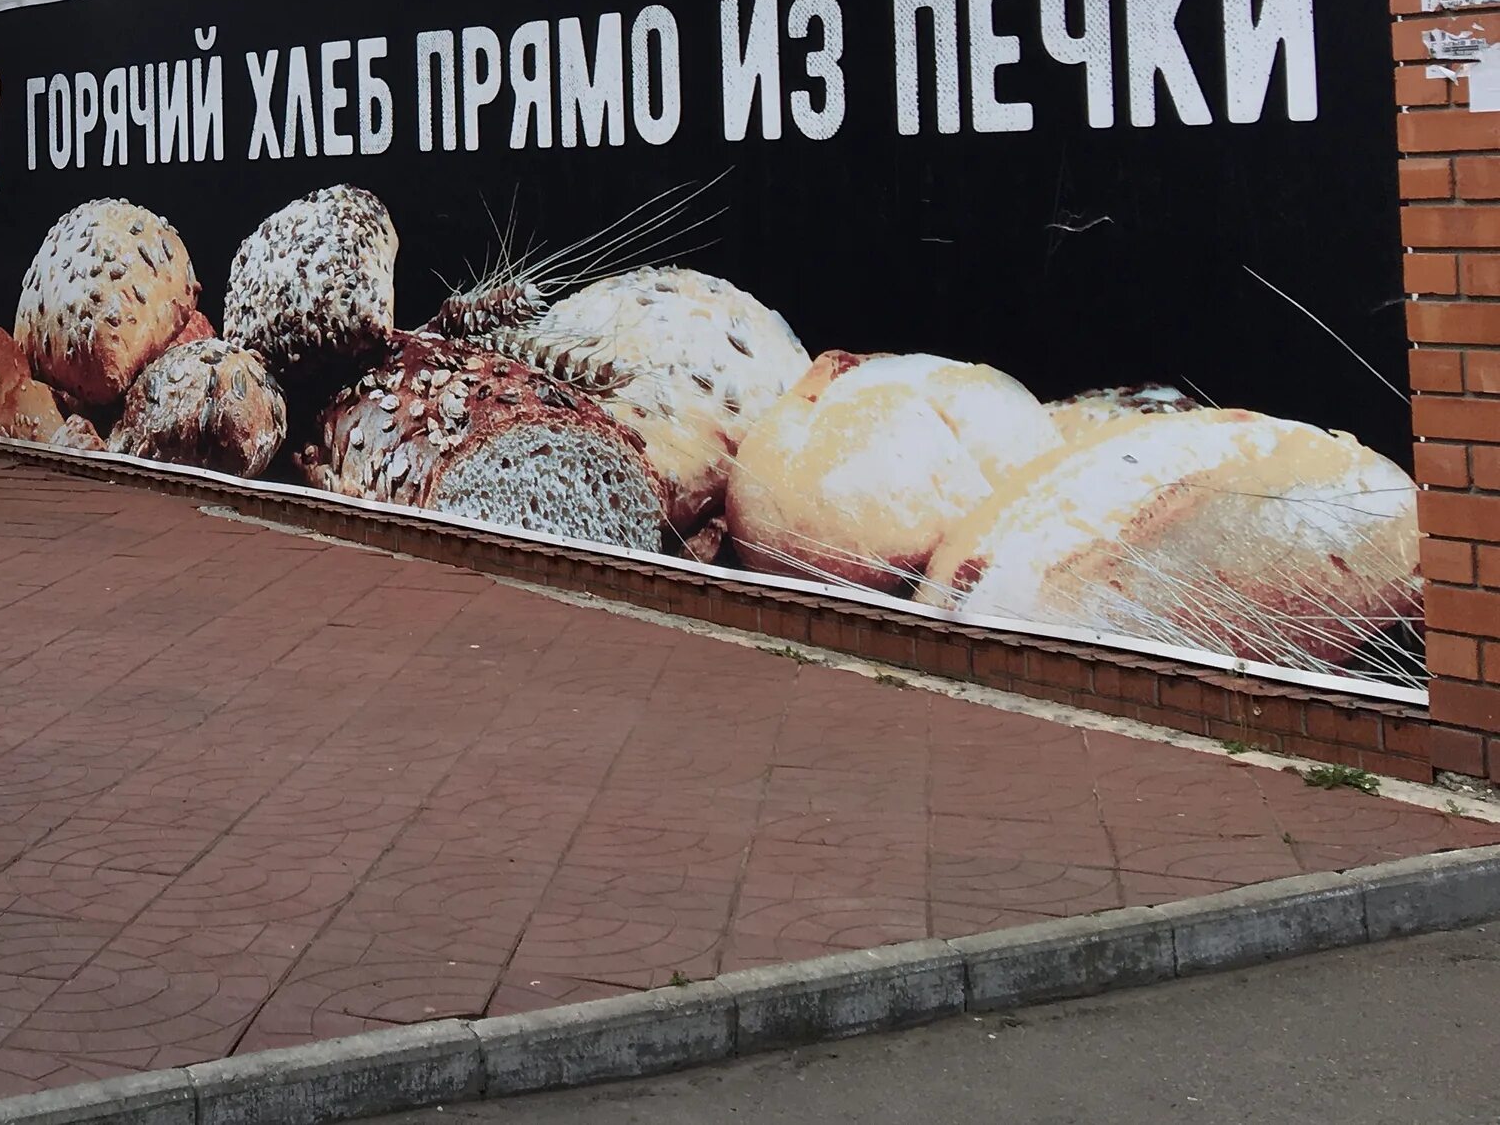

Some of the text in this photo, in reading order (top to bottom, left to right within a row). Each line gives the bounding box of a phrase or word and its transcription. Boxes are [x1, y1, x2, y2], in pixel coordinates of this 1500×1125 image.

[26, 25, 224, 171] ГОРЯЧИЙ
[245, 36, 394, 160] ХЛЕБ
[416, 4, 681, 152] ПРЯМО
